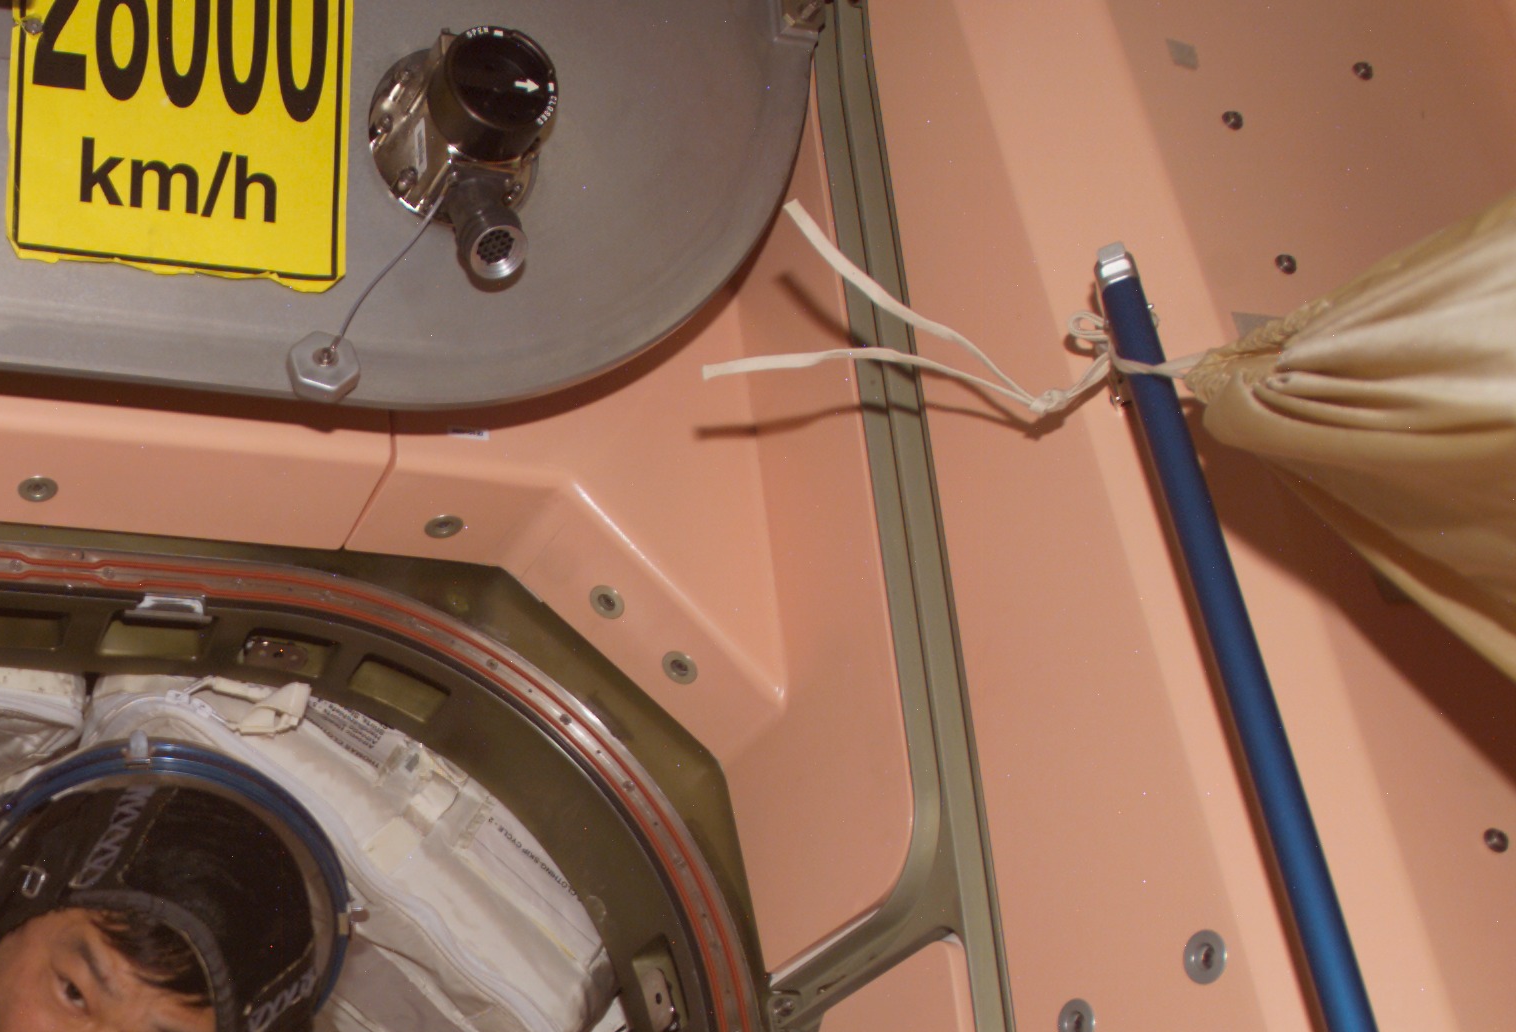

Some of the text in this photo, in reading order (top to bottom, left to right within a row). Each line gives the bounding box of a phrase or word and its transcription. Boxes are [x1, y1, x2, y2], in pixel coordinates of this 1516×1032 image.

[33, 0, 329, 122] 28000
[466, 26, 489, 39] OPEN
[535, 96, 557, 125] CLOSED
[79, 136, 277, 223] km/h
